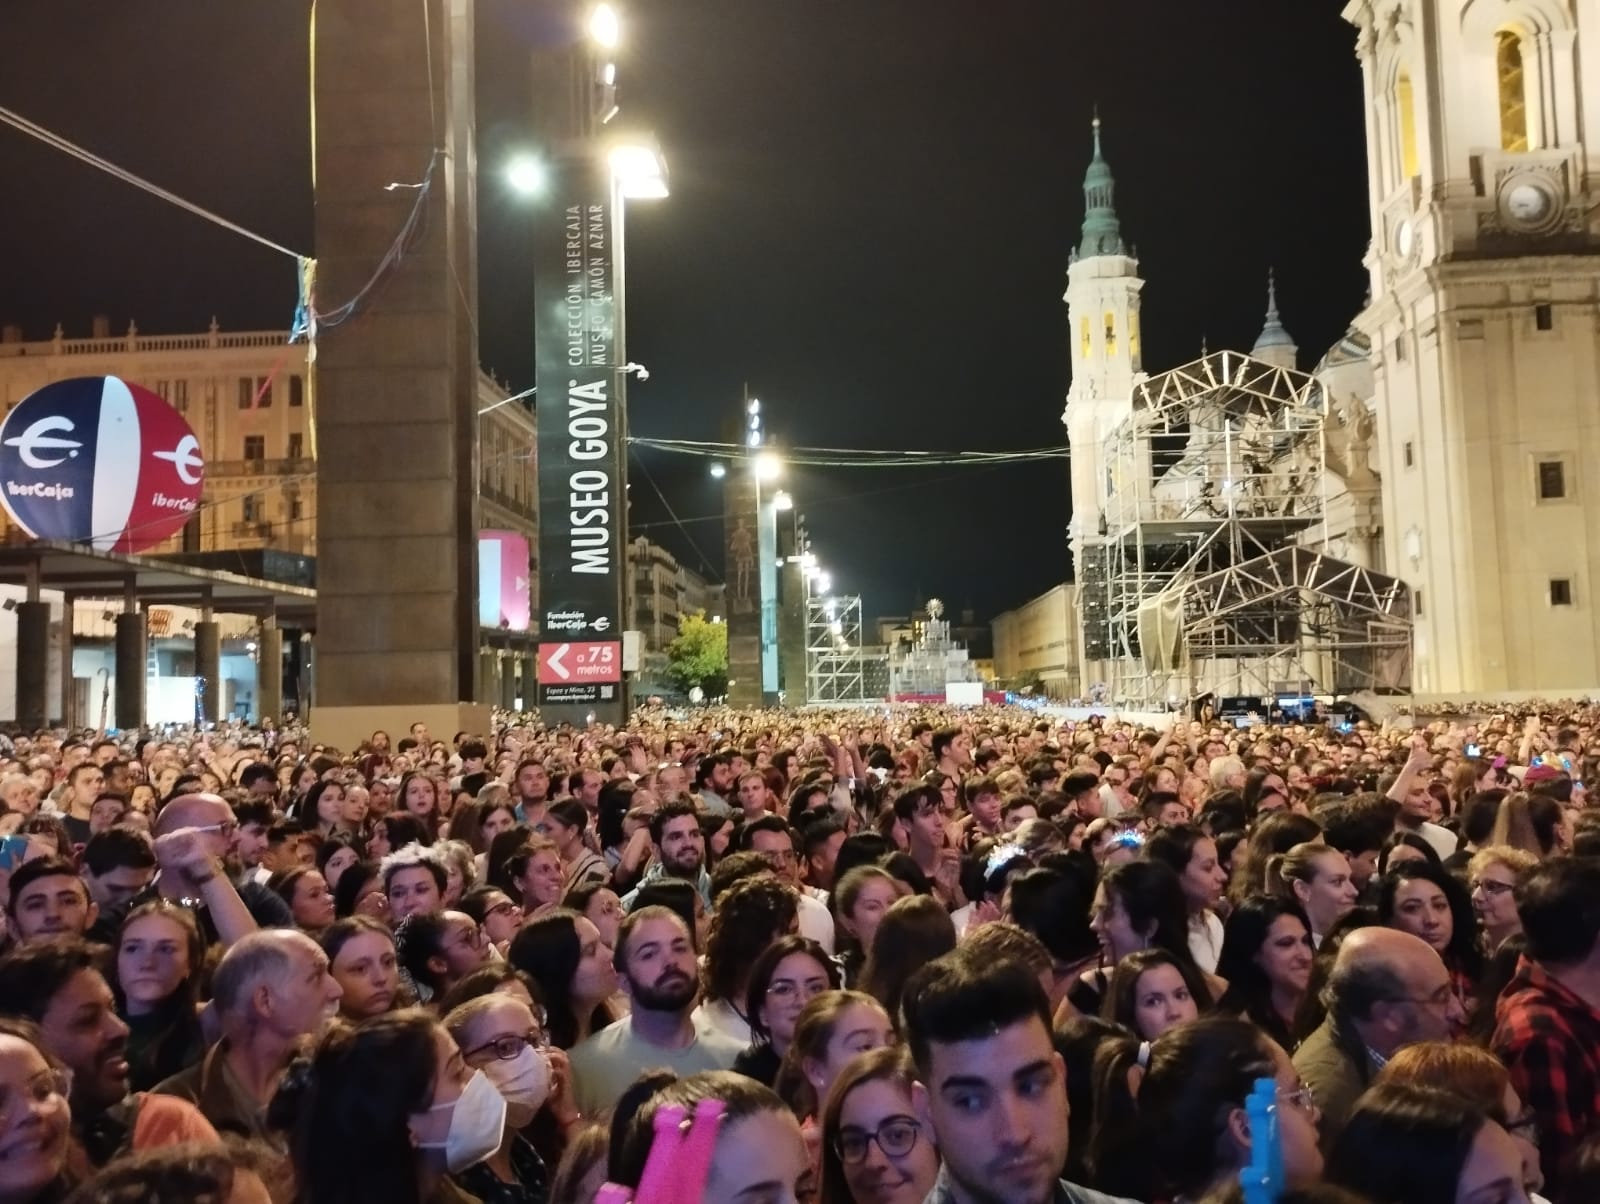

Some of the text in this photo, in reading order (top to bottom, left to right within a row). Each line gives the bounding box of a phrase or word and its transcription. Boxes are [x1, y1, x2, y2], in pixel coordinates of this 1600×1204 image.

[565, 204, 583, 366] COLECCIÓN IBERCAJA
[588, 204, 606, 365] MUSEO CAMÓN AZNAR
[568, 379, 610, 574] MUSEO GOYA
[547, 611, 585, 620] Fundación
[576, 646, 613, 663] a 75
[577, 665, 612, 676] metros
